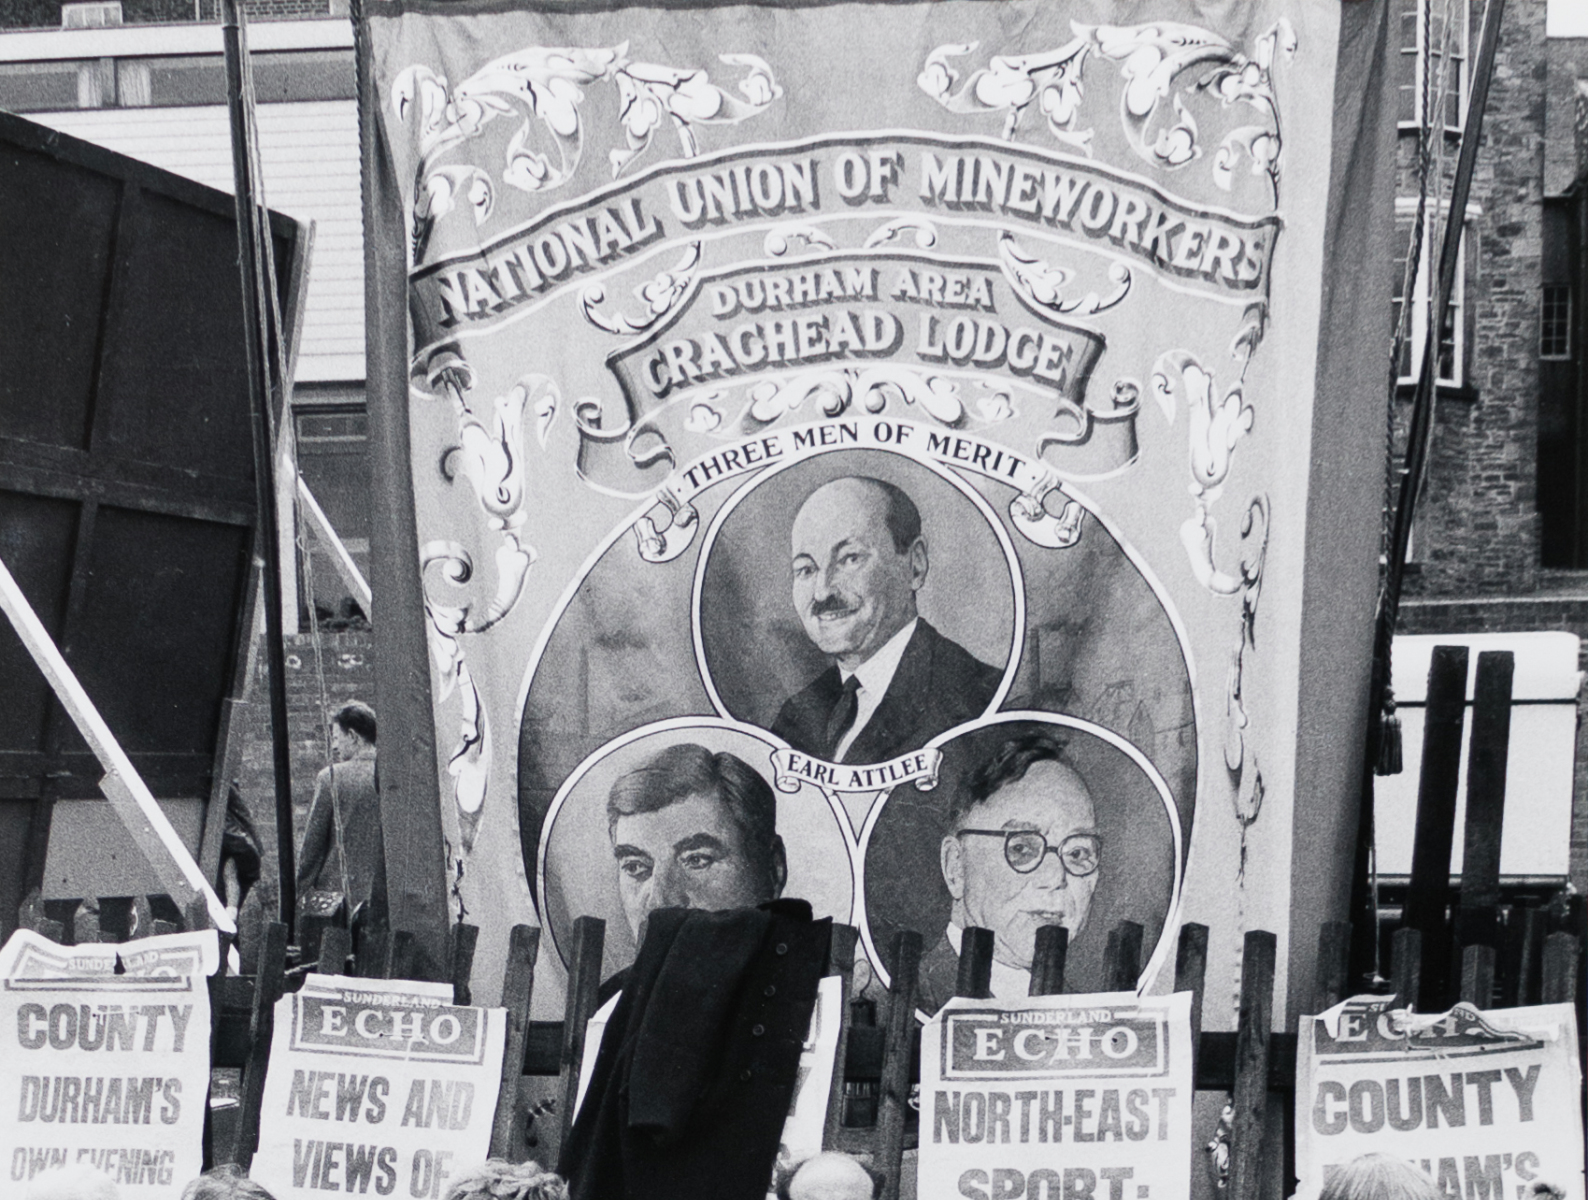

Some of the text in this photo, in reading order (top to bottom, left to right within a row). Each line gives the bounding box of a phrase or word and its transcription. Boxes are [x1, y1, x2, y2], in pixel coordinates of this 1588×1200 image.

[436, 150, 1265, 326] NATIONAL UNION OF MINEWORKERS
[710, 268, 996, 319] DURHAM AREA
[642, 310, 1073, 397] CRAGHEAD LODGE
[683, 421, 1028, 491] THREE MEN OF MERIT
[786, 754, 929, 788] EARL ATTLEE
[68, 951, 161, 970] SUNDELAND
[17, 1002, 194, 1053] COUNTY
[319, 1004, 463, 1046] ECHO
[1001, 1009, 1113, 1025] SUNDERLAND
[973, 1026, 1139, 1061] ECHO
[18, 1074, 183, 1126] DURHAM'S
[286, 1068, 475, 1131] NEWS AND
[932, 1087, 1177, 1144] NORTH-EAST
[1312, 1064, 1542, 1136] COUNTY
[292, 1137, 455, 1200] VIEWS OF
